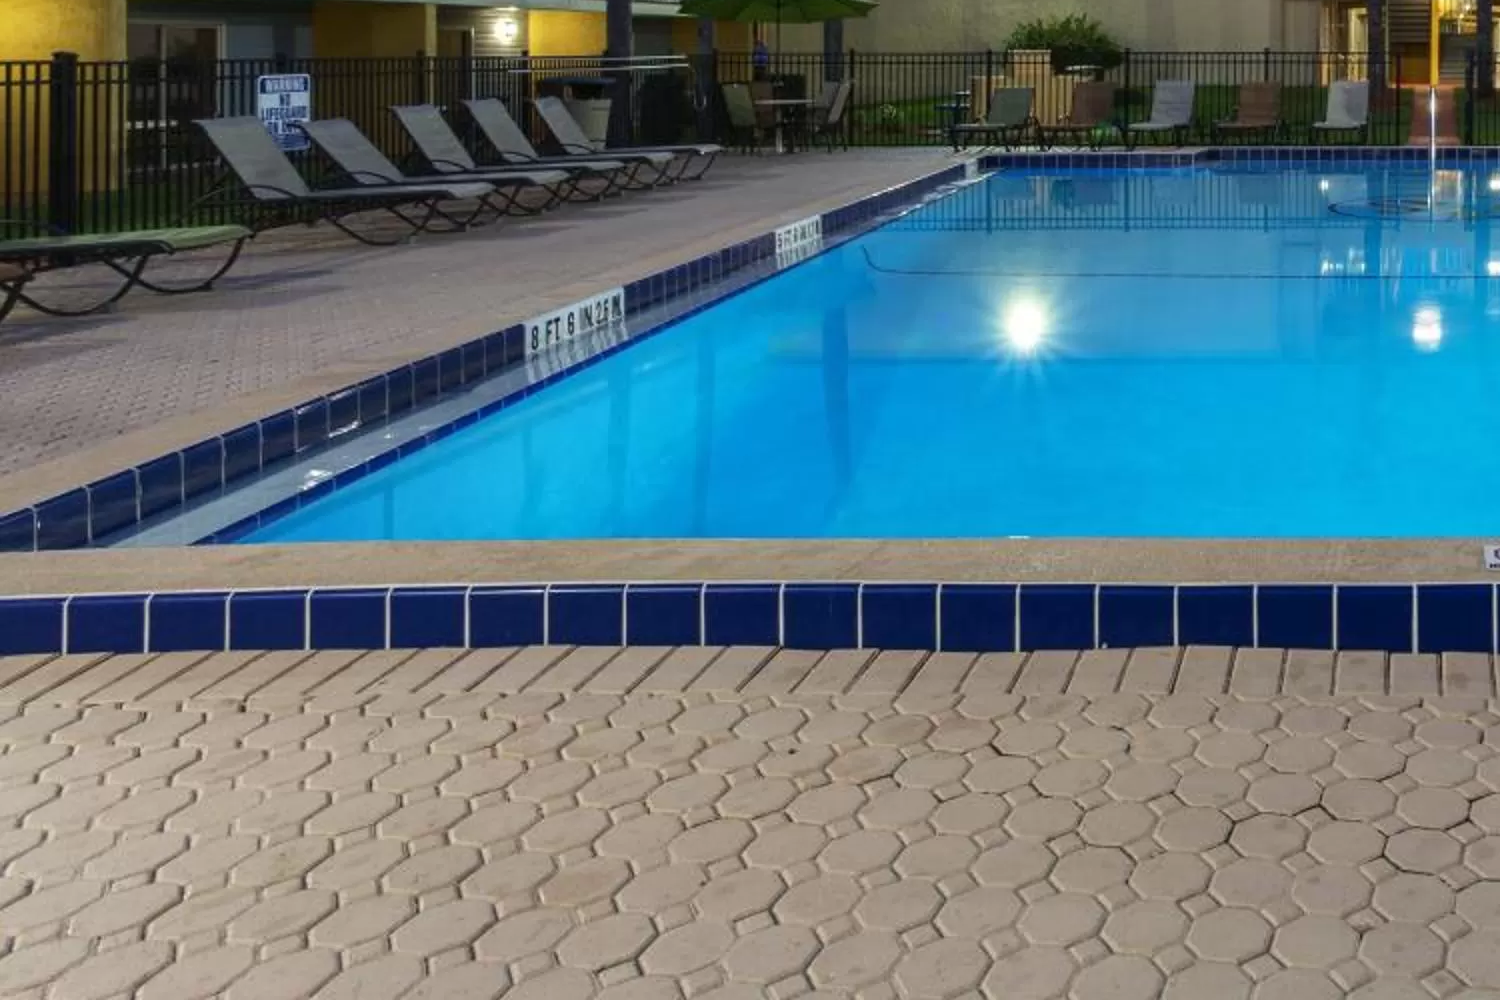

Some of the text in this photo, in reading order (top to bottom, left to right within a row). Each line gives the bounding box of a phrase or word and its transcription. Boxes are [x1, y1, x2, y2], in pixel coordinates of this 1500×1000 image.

[264, 78, 304, 92] WARNING
[280, 93, 290, 106] NO
[261, 105, 307, 120] LIFEGUARD
[531, 325, 539, 350] 8
[567, 311, 575, 336] 6
